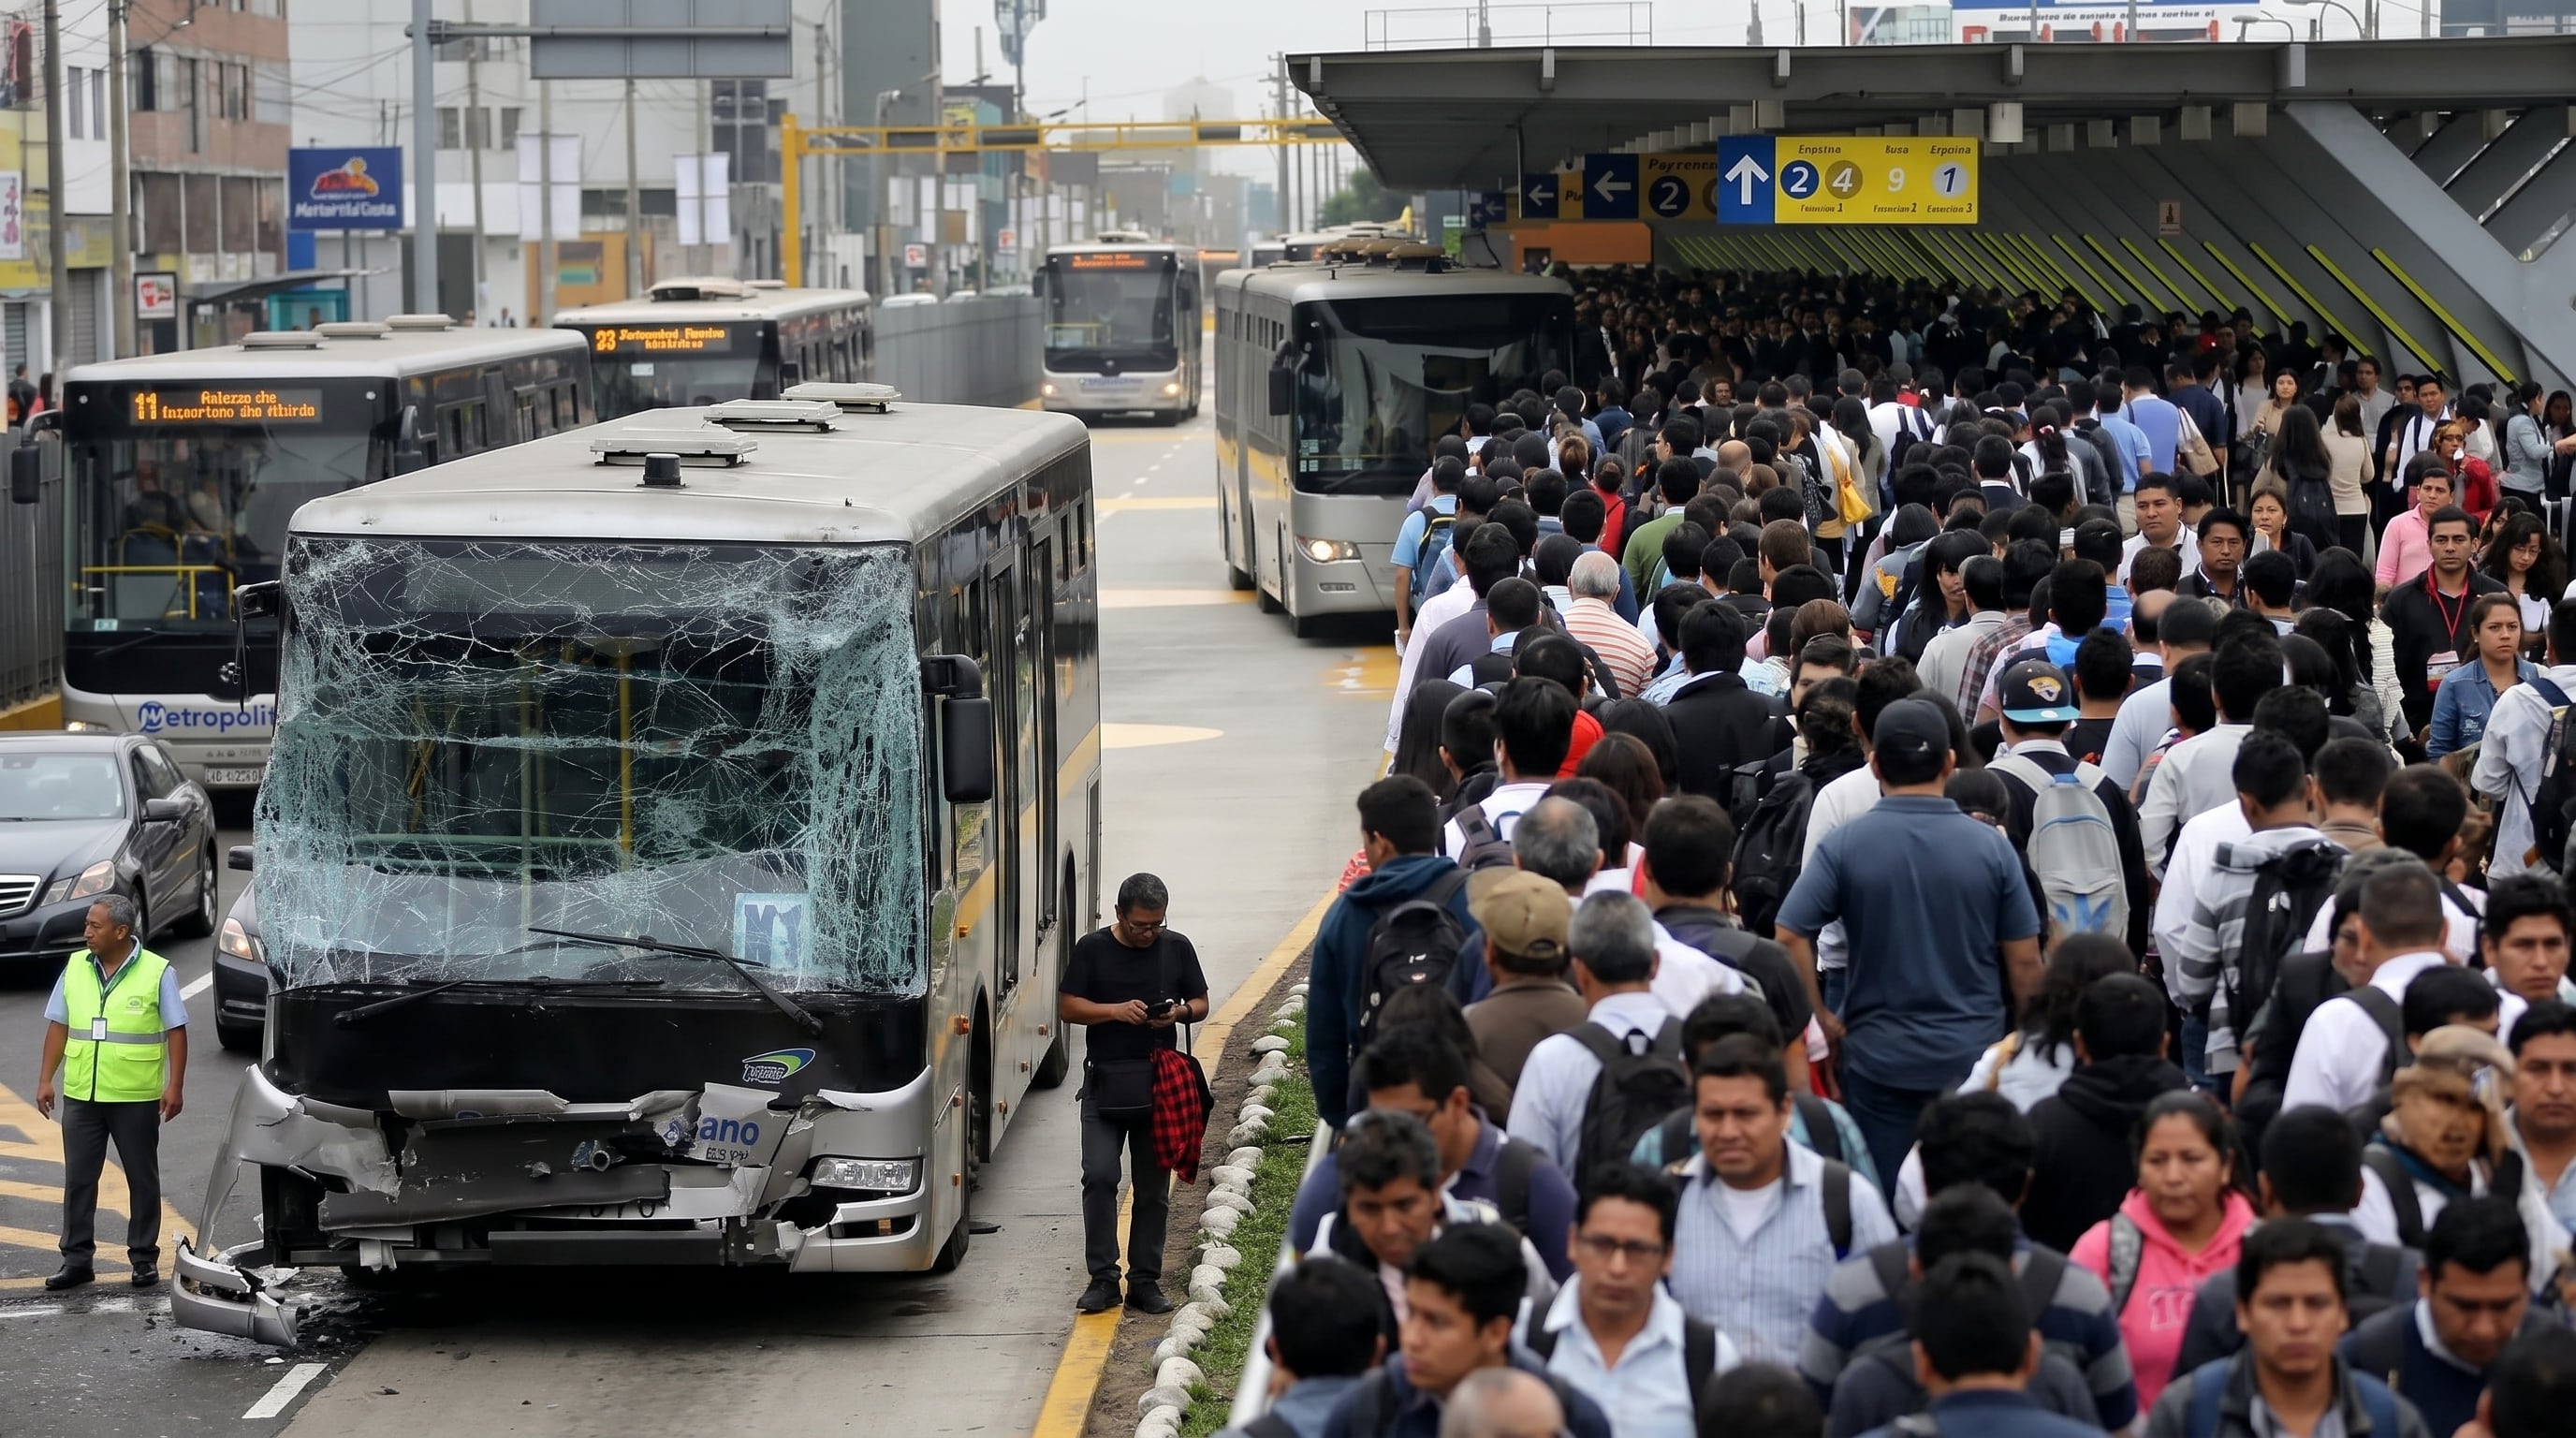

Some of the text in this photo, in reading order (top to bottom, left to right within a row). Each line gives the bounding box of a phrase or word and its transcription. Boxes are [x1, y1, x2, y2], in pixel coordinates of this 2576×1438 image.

[1790, 166, 1956, 193] 2 4 9 1
[1659, 182, 1679, 210] 2
[1837, 202, 1843, 213] 1
[1910, 202, 1917, 213] 2
[1966, 202, 1973, 213] 3
[595, 329, 616, 351] 23
[135, 392, 157, 419] 11
[255, 389, 277, 404] che
